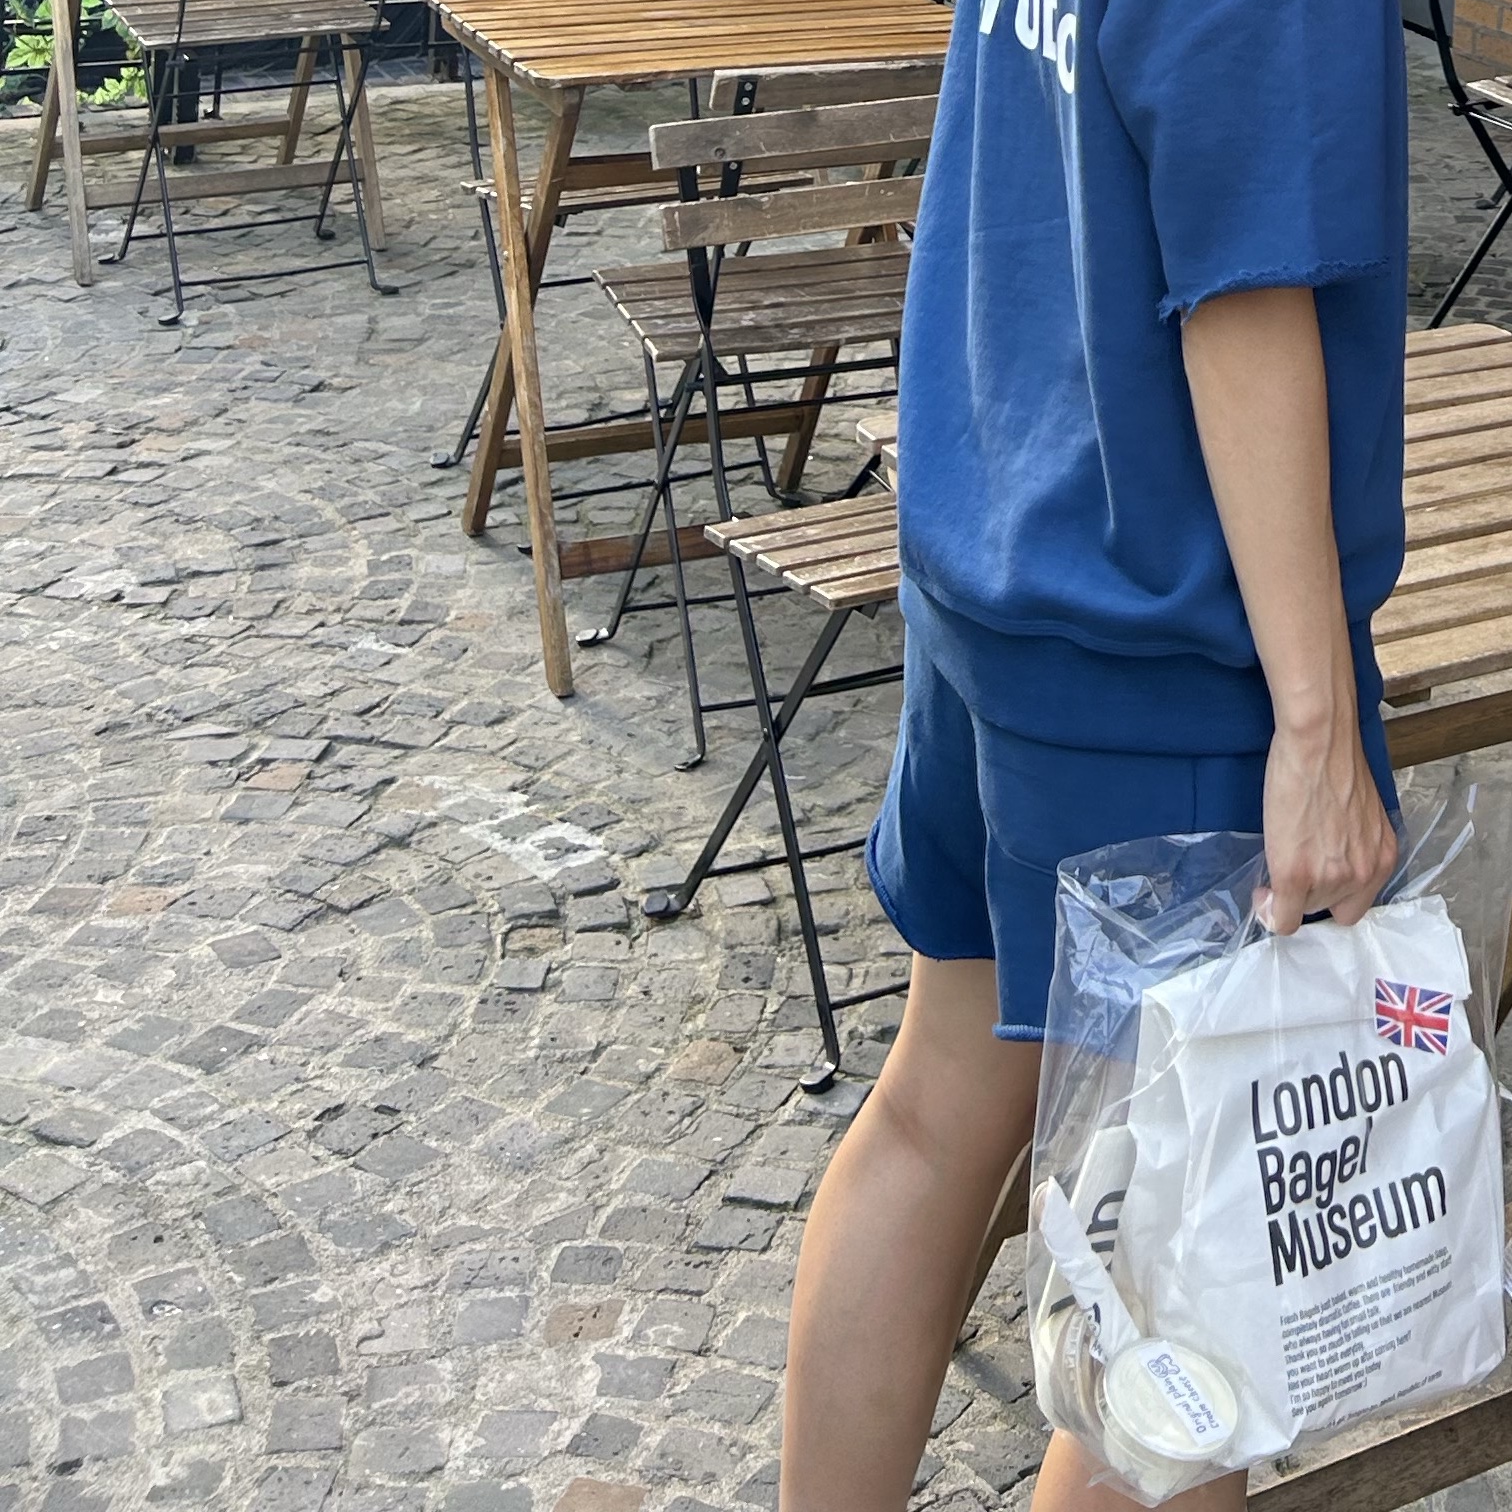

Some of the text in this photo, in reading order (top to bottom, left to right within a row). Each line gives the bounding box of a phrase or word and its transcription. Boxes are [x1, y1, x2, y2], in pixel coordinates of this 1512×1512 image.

[1251, 1050, 1409, 1144] London
[1257, 1116, 1373, 1216] Bagel
[1268, 1166, 1447, 1286] Museum
